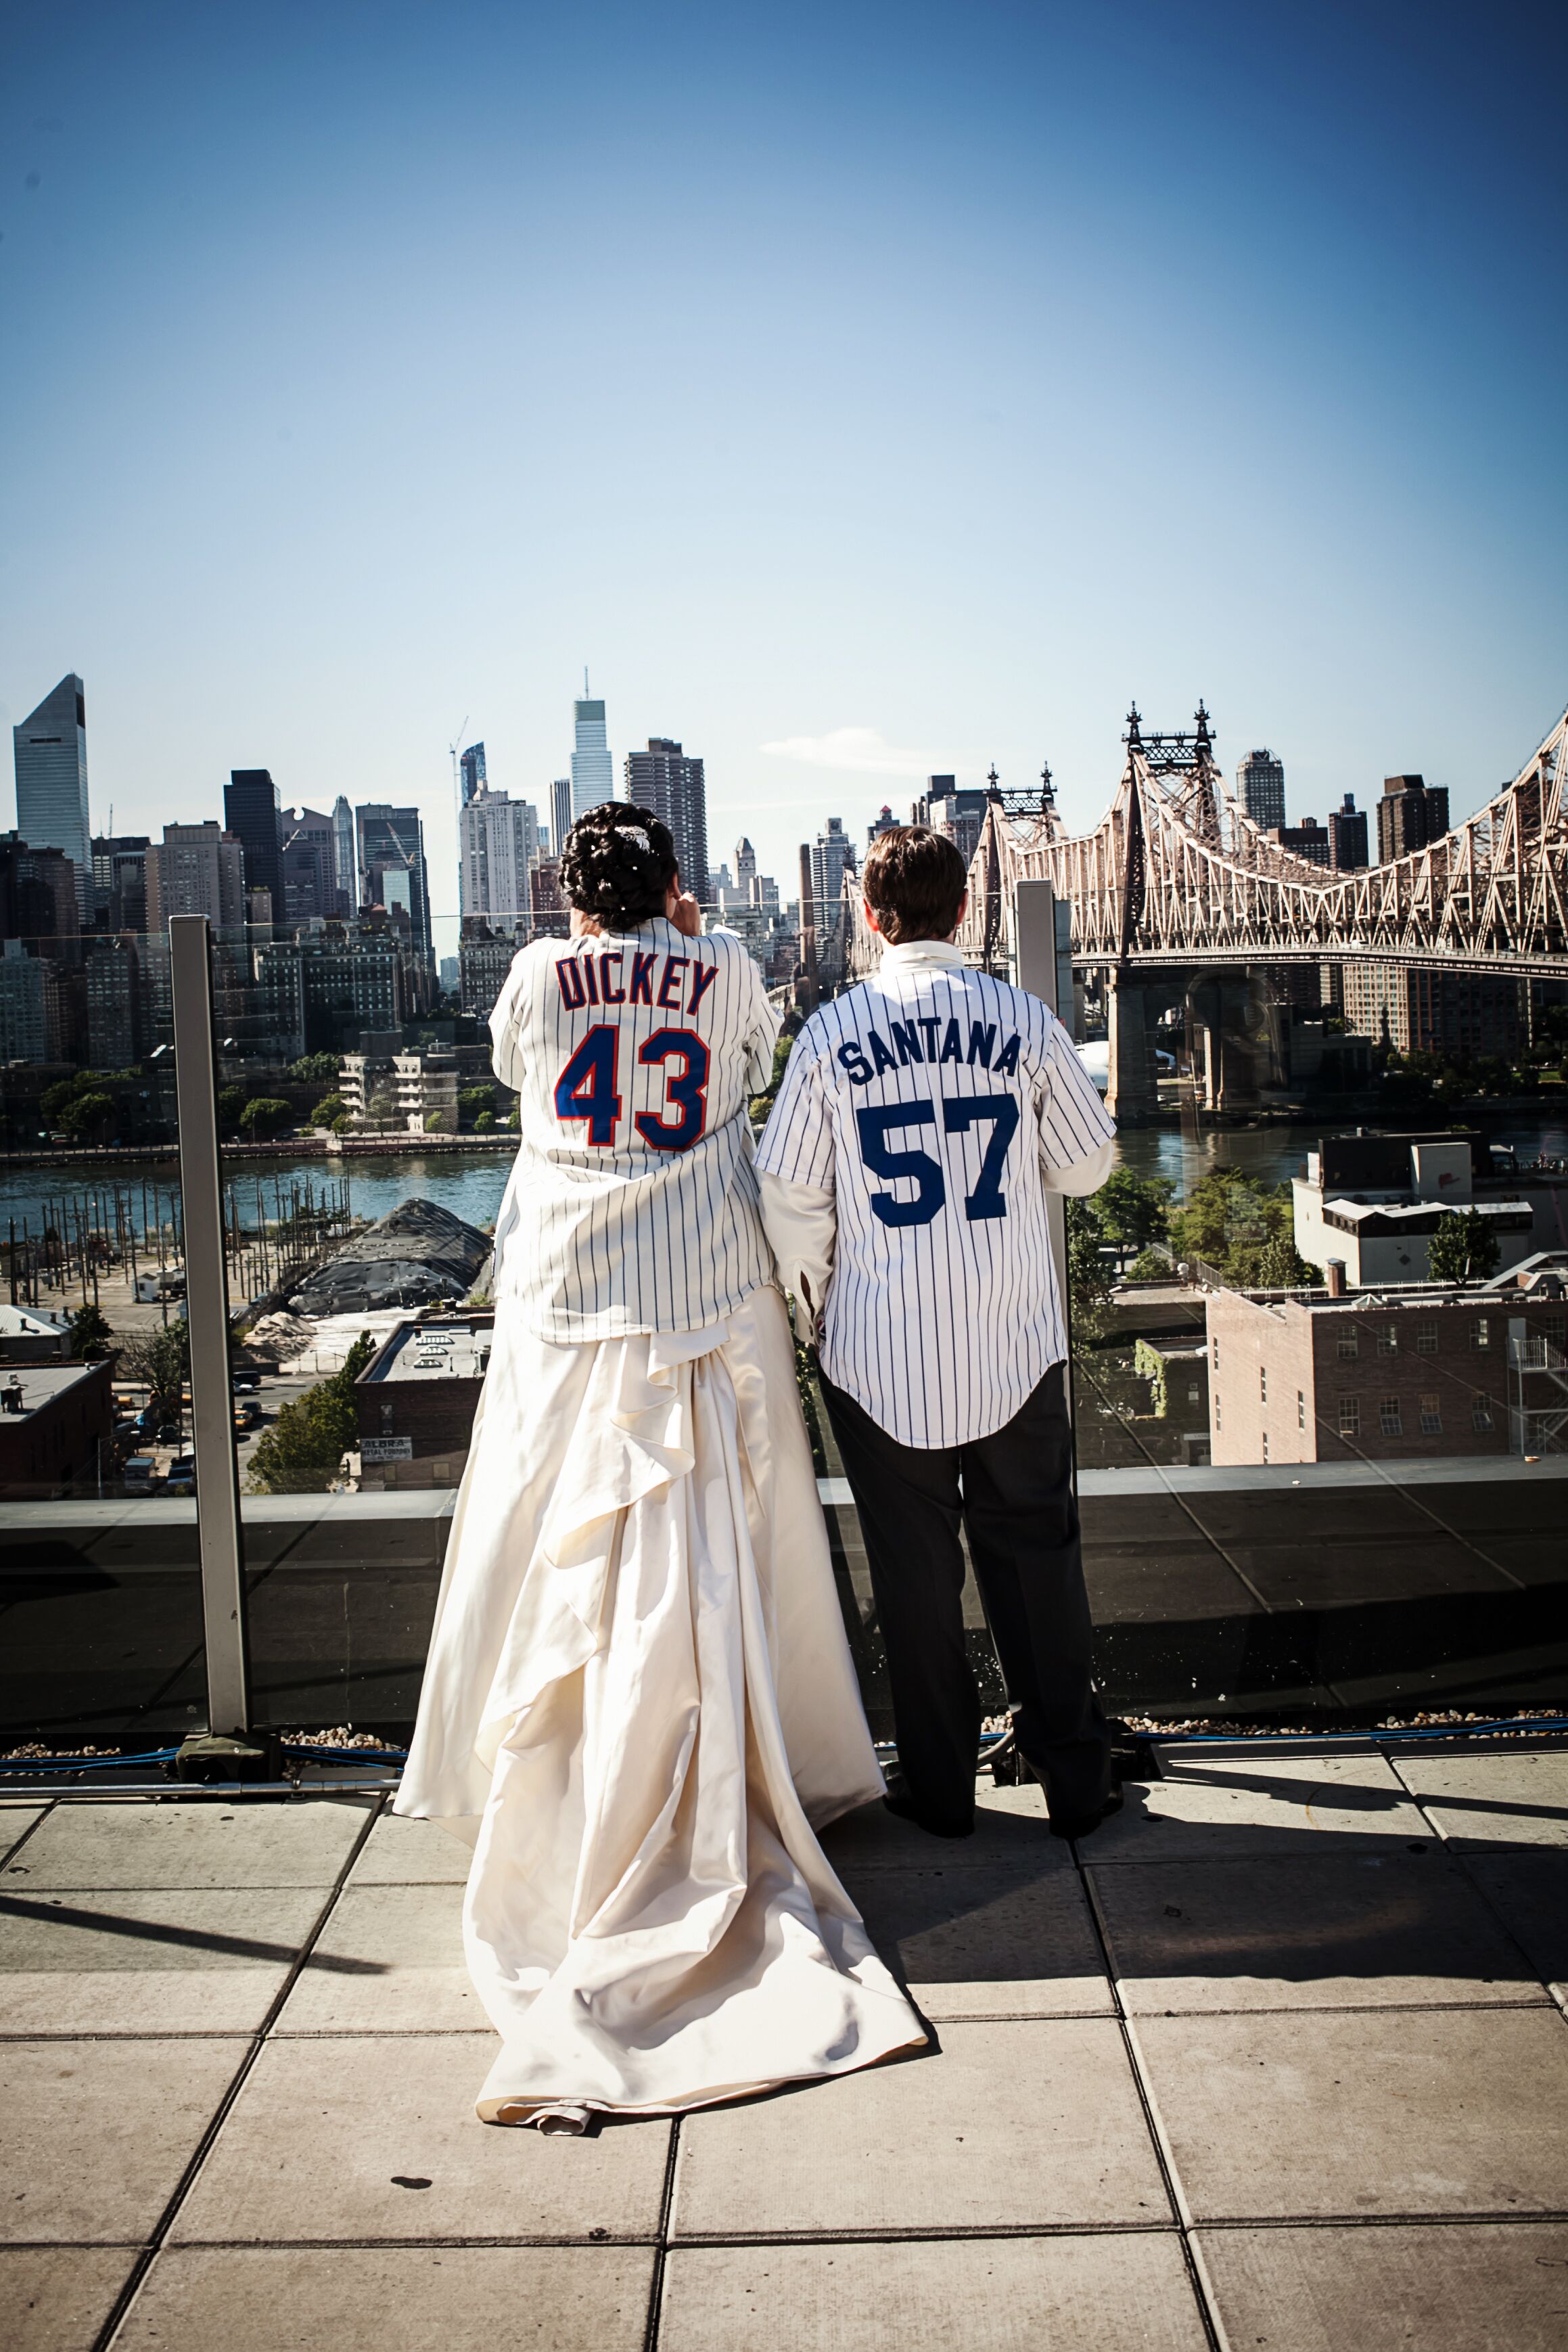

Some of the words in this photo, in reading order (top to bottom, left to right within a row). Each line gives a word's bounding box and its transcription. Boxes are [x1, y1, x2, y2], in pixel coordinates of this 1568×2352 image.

[555, 952, 719, 1016] DICKEY
[554, 1024, 710, 1150] 43
[837, 1017, 1021, 1085] SANTANA
[856, 1093, 1019, 1228] 57
